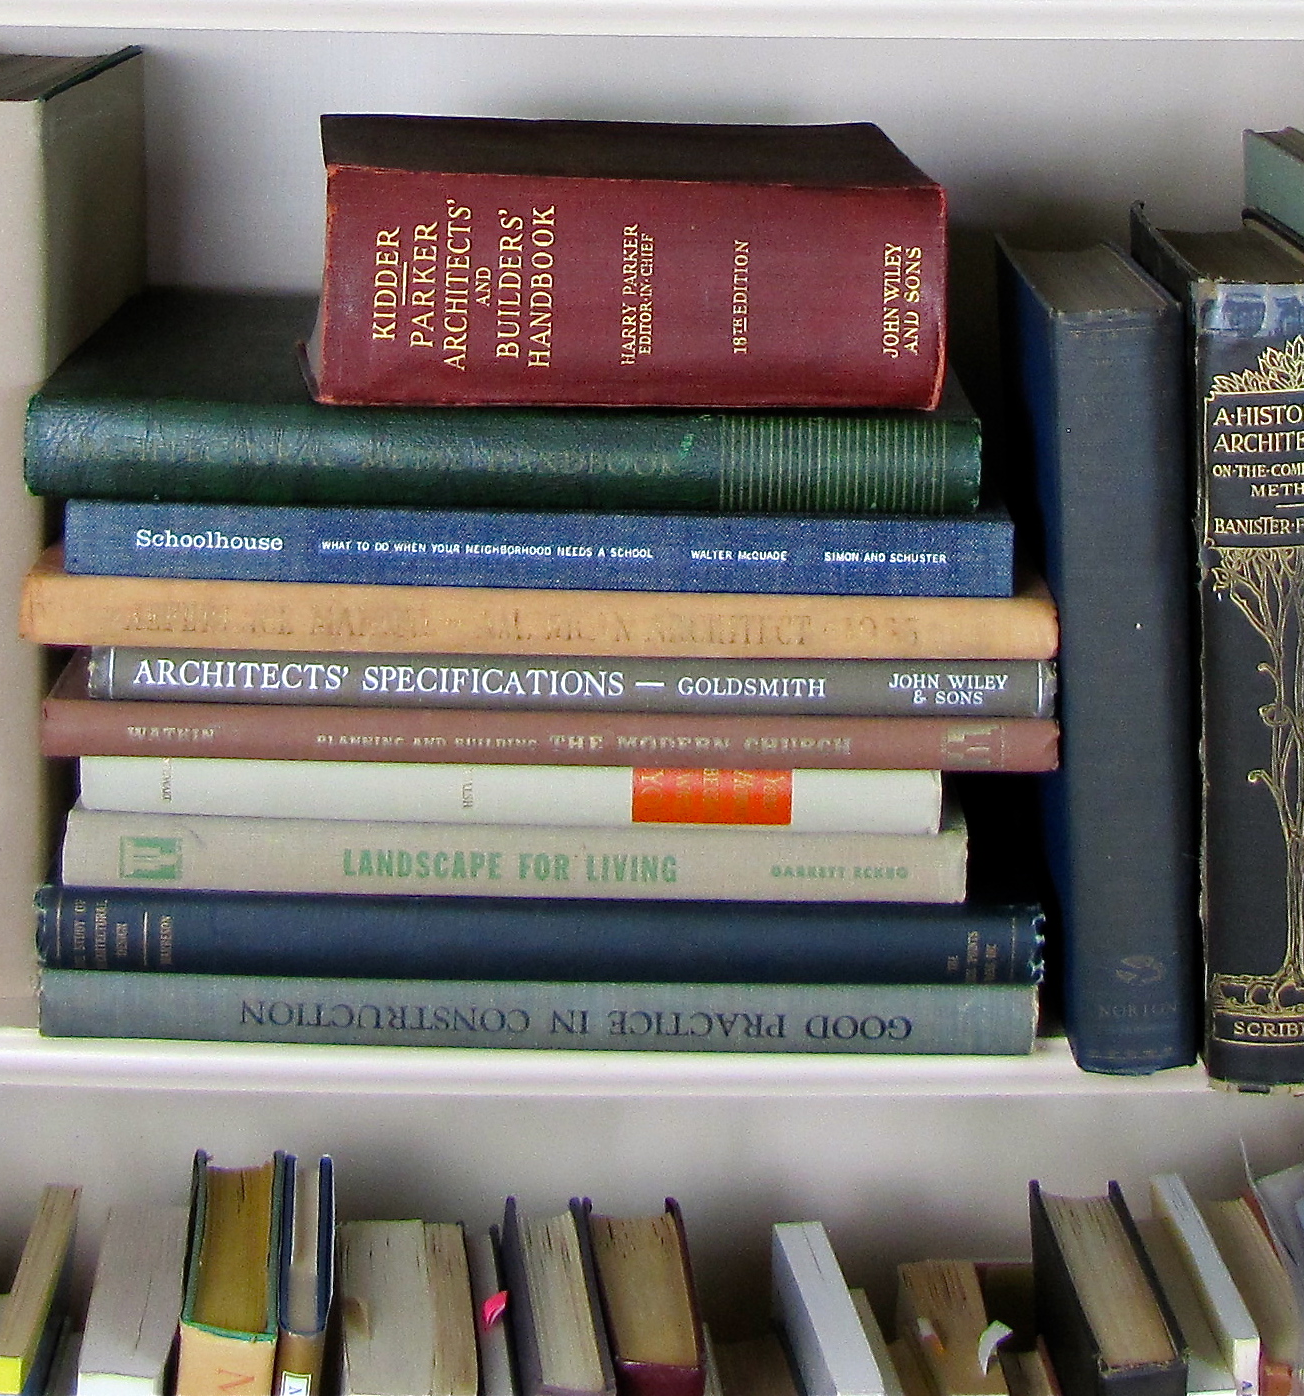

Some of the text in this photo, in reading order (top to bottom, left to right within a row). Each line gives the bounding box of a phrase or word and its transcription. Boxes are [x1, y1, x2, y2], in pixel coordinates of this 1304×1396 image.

[371, 225, 401, 342] KIDDER
[409, 220, 439, 349] PARKER
[442, 197, 474, 372] ARCHITECTS'
[474, 265, 492, 307] AND
[494, 207, 525, 360] BUILDERS'
[527, 204, 557, 369] HANDBOOK
[620, 223, 639, 367] HARRY PARKER
[733, 238, 749, 316] EDITION
[882, 241, 903, 360] JOHN WILEY
[903, 245, 923, 356] AND SONS
[135, 528, 949, 565] Schoolhouse WHAT WHEN SCHOOL WALTER SIMON SCHUSTER
[132, 658, 827, 699] ARCHITECTS' SPECIFICATIONS GOLDSMITH
[888, 672, 1010, 691] JOHN WILEY
[934, 690, 984, 705] SONS
[549, 733, 605, 752] THE
[342, 847, 678, 885] LANDSCAPE FOR LIVING
[239, 998, 914, 1041] GOOD PRACTICE IN CONSTRUCTION
